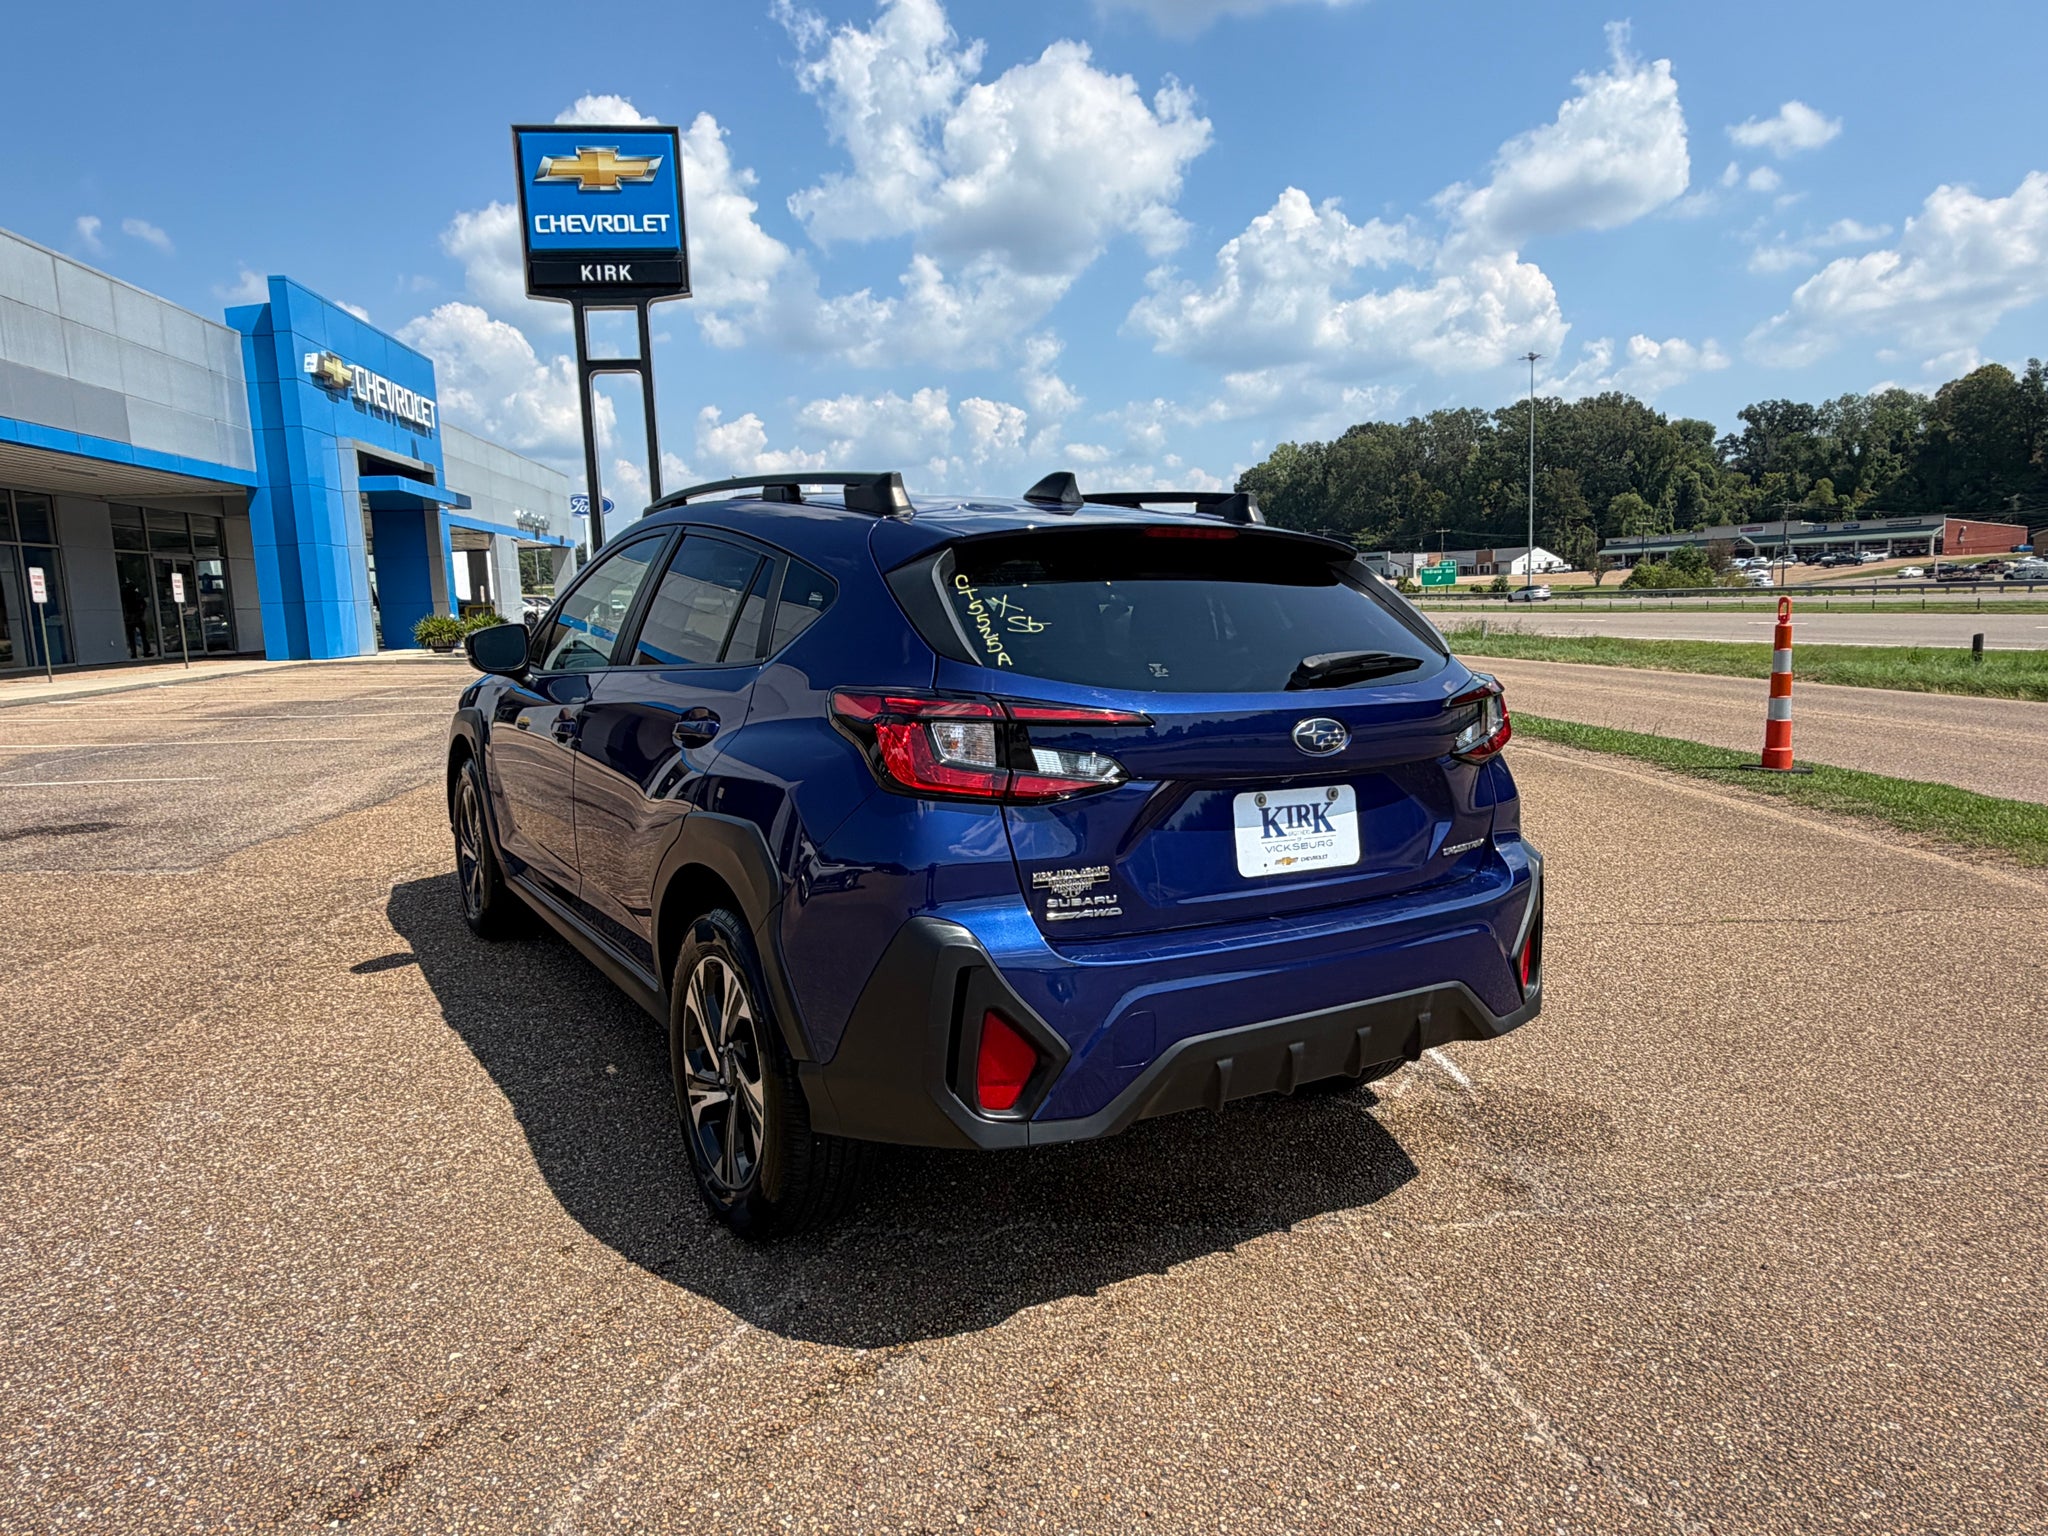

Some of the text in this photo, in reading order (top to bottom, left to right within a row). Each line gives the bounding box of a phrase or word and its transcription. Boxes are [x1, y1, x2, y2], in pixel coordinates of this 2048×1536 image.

[534, 214, 671, 233] CHEVROLET
[580, 264, 633, 282] KIRK
[353, 364, 436, 429] CHEVROLET
[1259, 802, 1336, 839] KIRK
[1265, 839, 1334, 853] VICKSBURG
[1047, 895, 1117, 908] SUBARU
[1076, 907, 1123, 918] AWD
